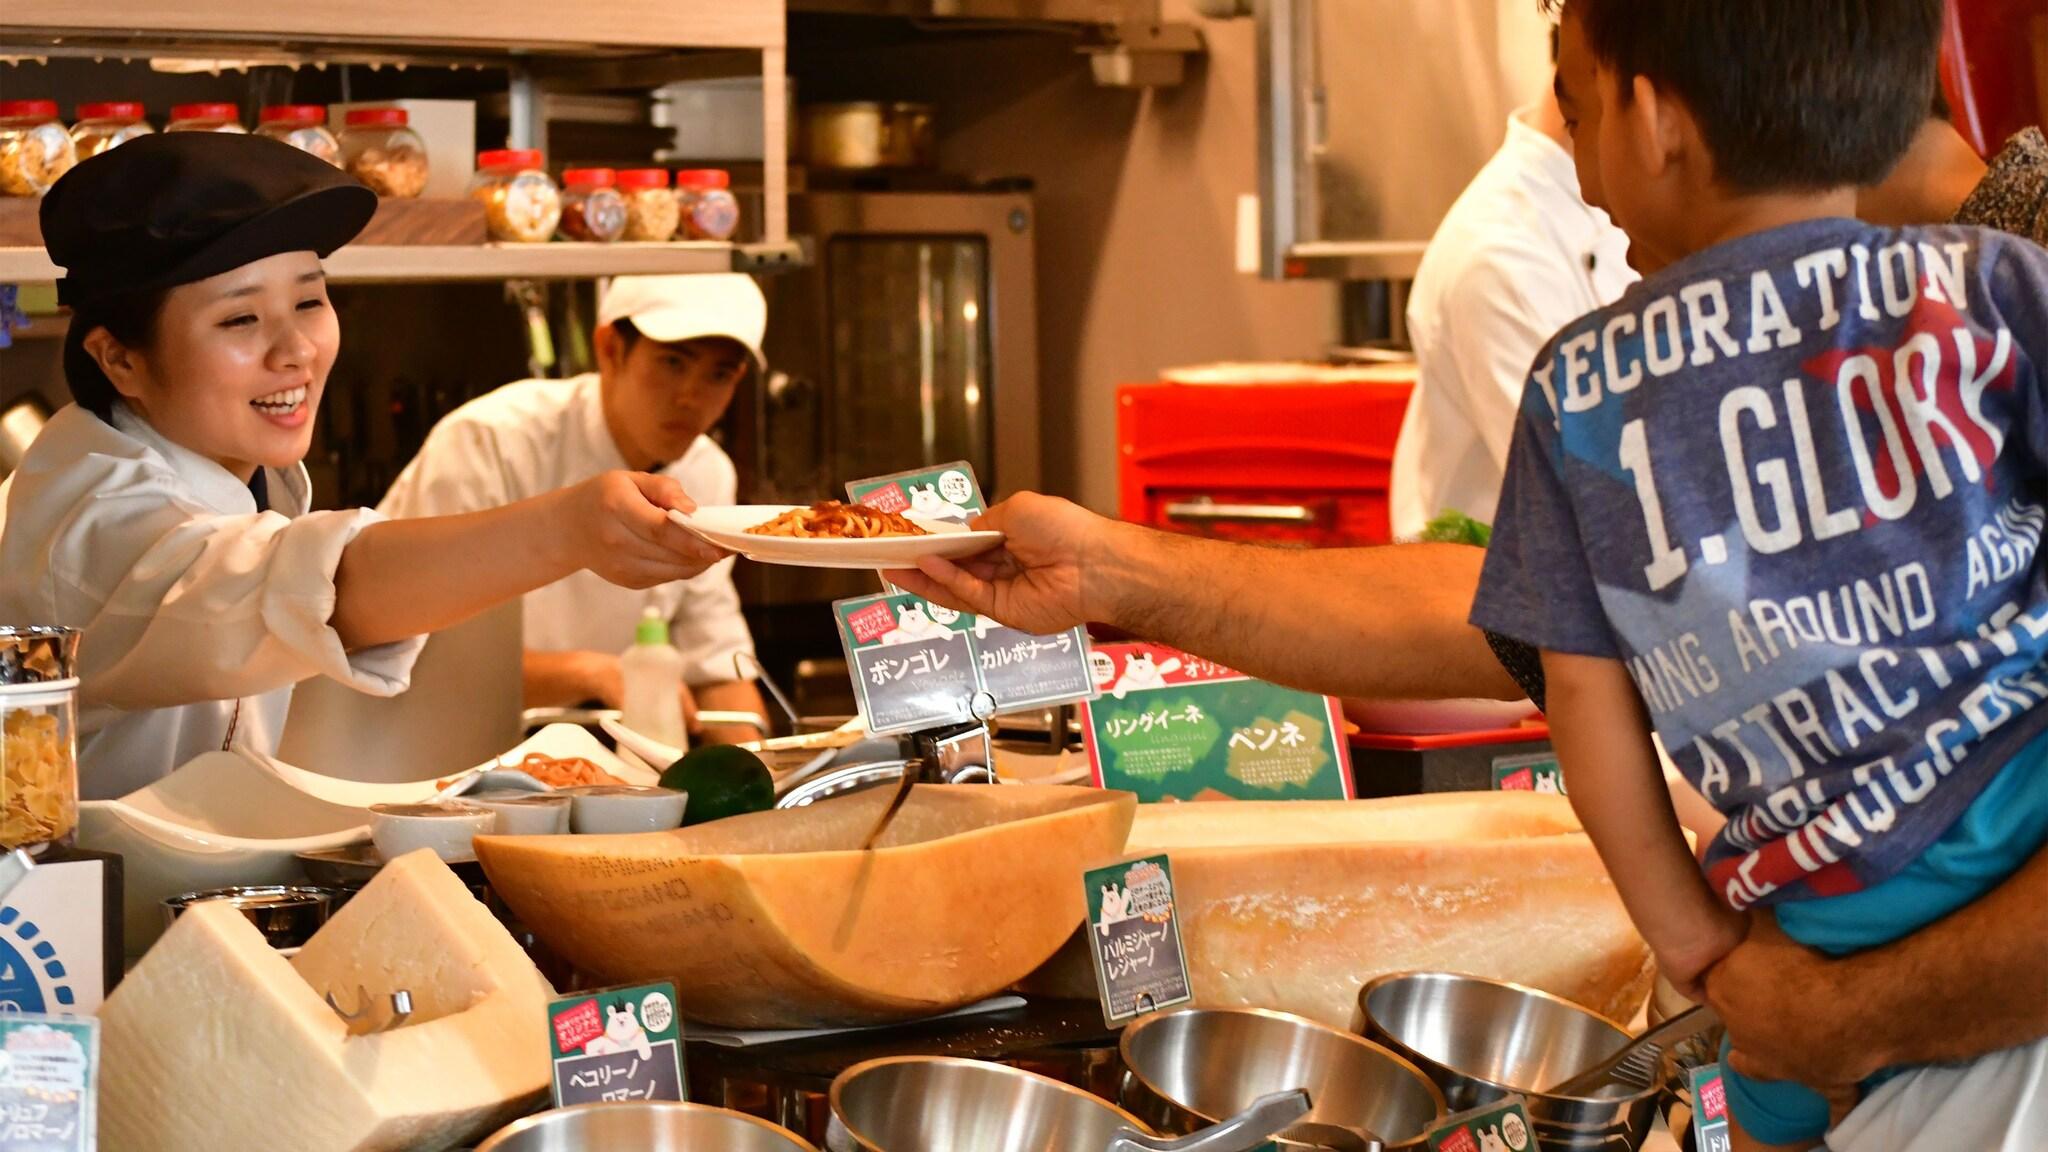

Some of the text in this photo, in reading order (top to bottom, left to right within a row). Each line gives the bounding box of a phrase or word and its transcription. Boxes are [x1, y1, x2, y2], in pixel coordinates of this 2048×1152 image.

[1620, 327, 2010, 592] 1.GLORY
[1728, 561, 1936, 672] AROUND
[869, 648, 950, 686] ボンゴレ
[979, 633, 1072, 670] カルボナーラ
[1105, 704, 1205, 739] リングイーネ
[1228, 721, 1307, 752] ペンネ
[1103, 921, 1168, 961] パルミジャーノ
[1107, 946, 1154, 980] レジャーノ
[569, 1058, 639, 1088] ペコリーノ
[601, 1079, 656, 1102] ロマーノ
